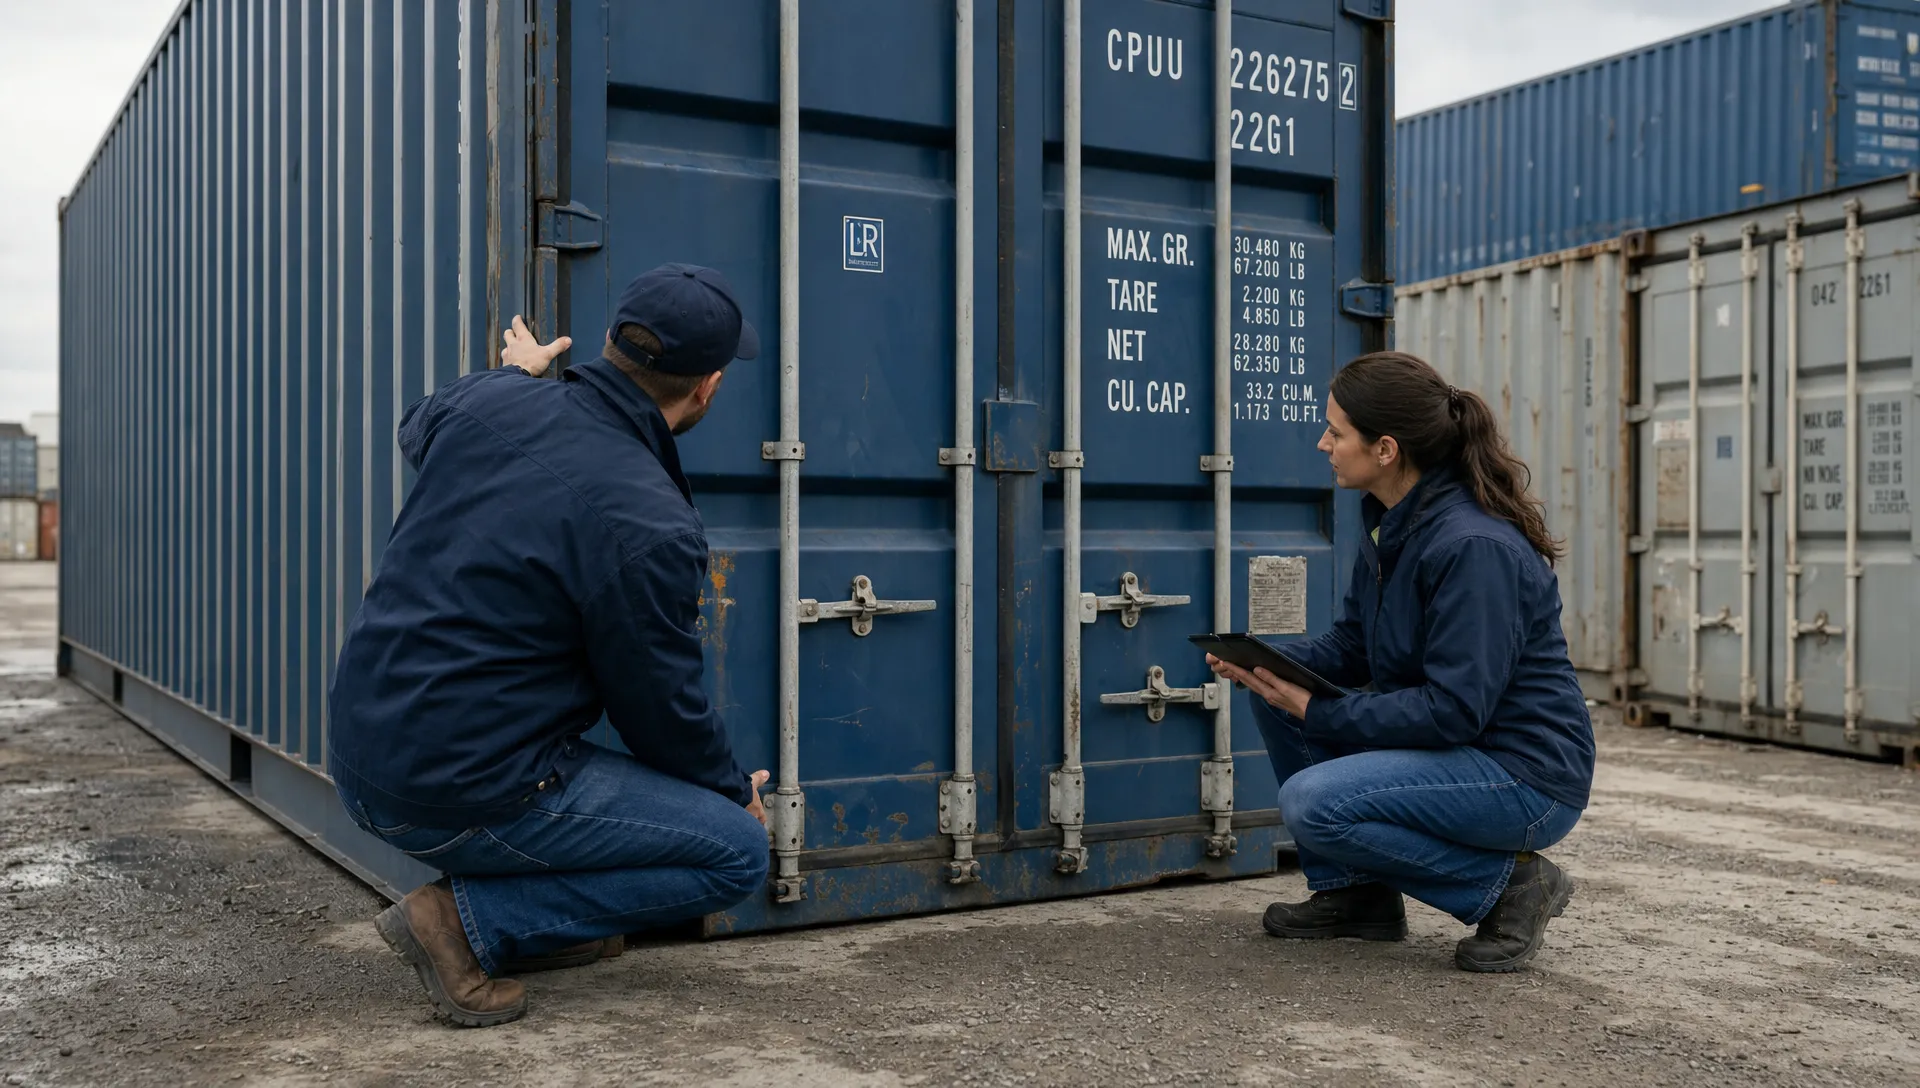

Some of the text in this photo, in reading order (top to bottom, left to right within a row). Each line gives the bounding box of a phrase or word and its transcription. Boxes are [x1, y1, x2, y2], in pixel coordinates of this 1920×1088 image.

[1108, 29, 1355, 106] CPUU 226275 2
[1231, 110, 1294, 156] 22G1
[1108, 228, 1194, 266] MAX. GR.
[1235, 236, 1305, 259] 30.480 KG
[1235, 258, 1305, 279] 67.200 LB
[1108, 279, 1158, 313] TARE
[1244, 286, 1305, 306] 2.200 KG
[1811, 281, 1837, 306] 042
[1243, 307, 1305, 327] 4.850 LB
[1108, 329, 1147, 361] NET
[1235, 333, 1305, 353] 28.280 KG
[1235, 354, 1305, 374] 62.350 LB
[1108, 379, 1190, 413] CU. CAP.
[1247, 382, 1317, 401] 33.2 CU.M.
[1234, 403, 1322, 422] 1.173 CU.FT.
[1803, 437, 1826, 456] TARE
